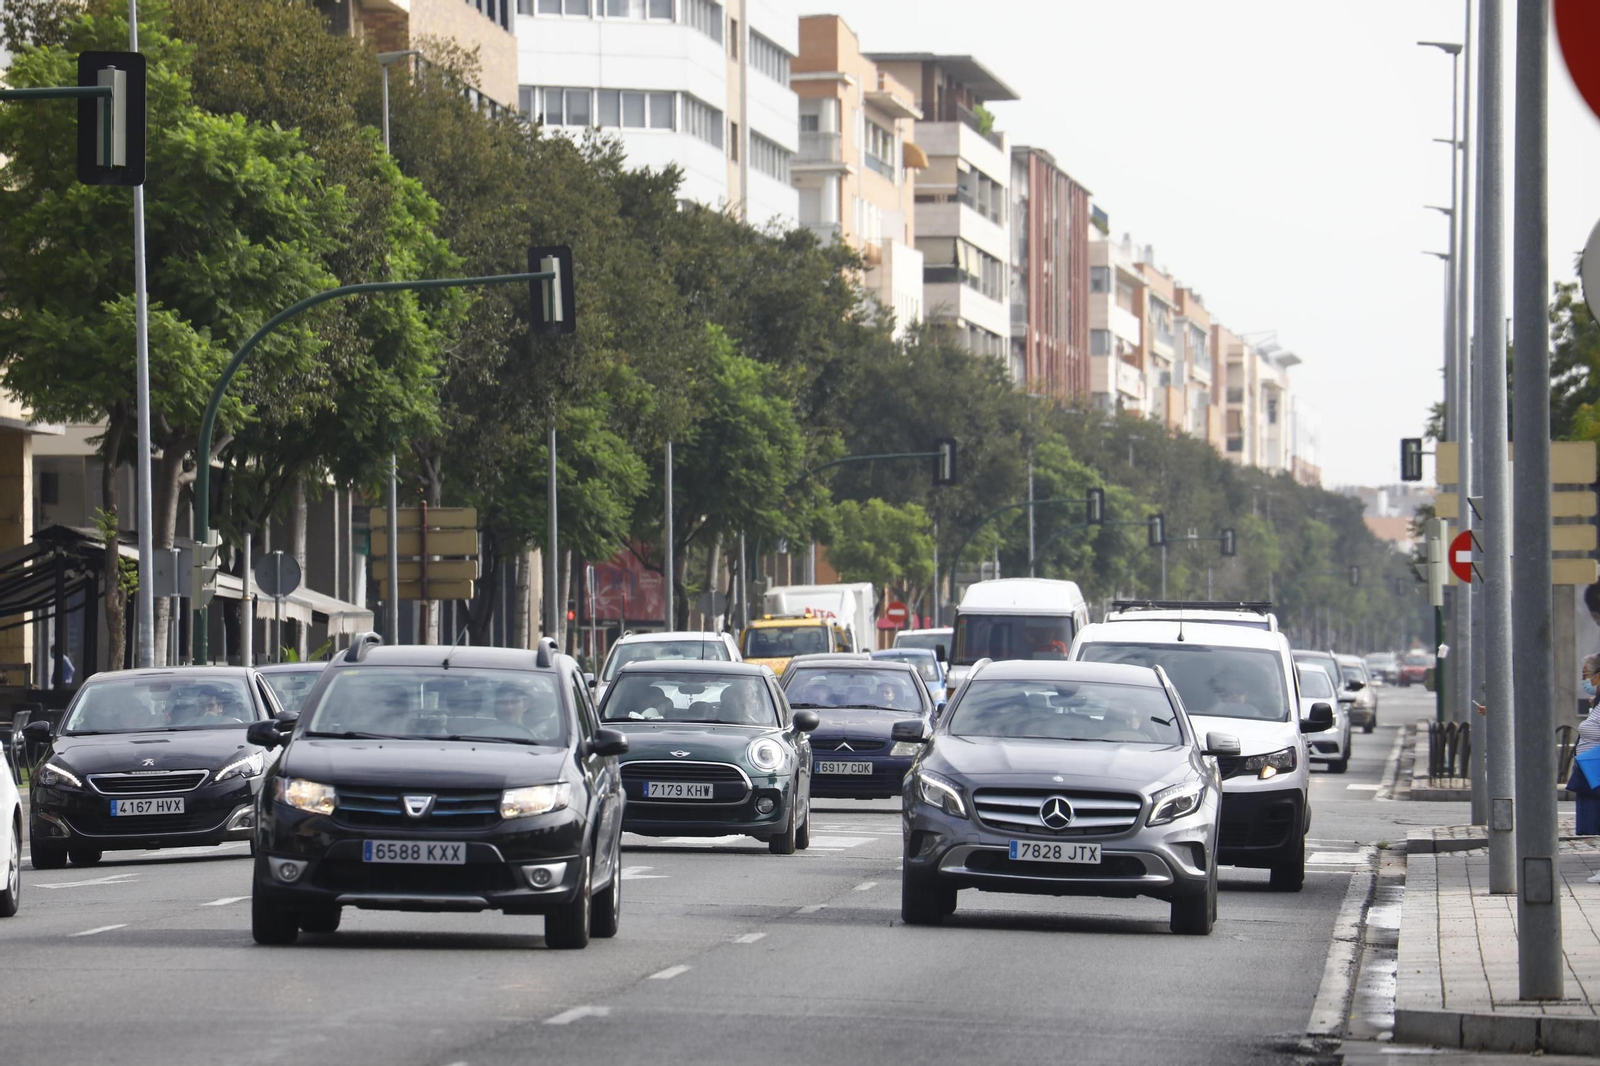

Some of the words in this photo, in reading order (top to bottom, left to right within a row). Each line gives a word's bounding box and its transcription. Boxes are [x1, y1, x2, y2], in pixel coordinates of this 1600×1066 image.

[822, 763, 847, 772] 6917
[851, 763, 870, 773] CDK
[651, 784, 682, 796] 7179
[687, 785, 710, 797] KHW
[120, 801, 152, 813] 4167
[156, 800, 181, 812] HVX
[376, 843, 421, 860] 6588
[427, 845, 460, 861] KXX
[1021, 843, 1062, 859] 7828
[1068, 846, 1098, 861] JTX
